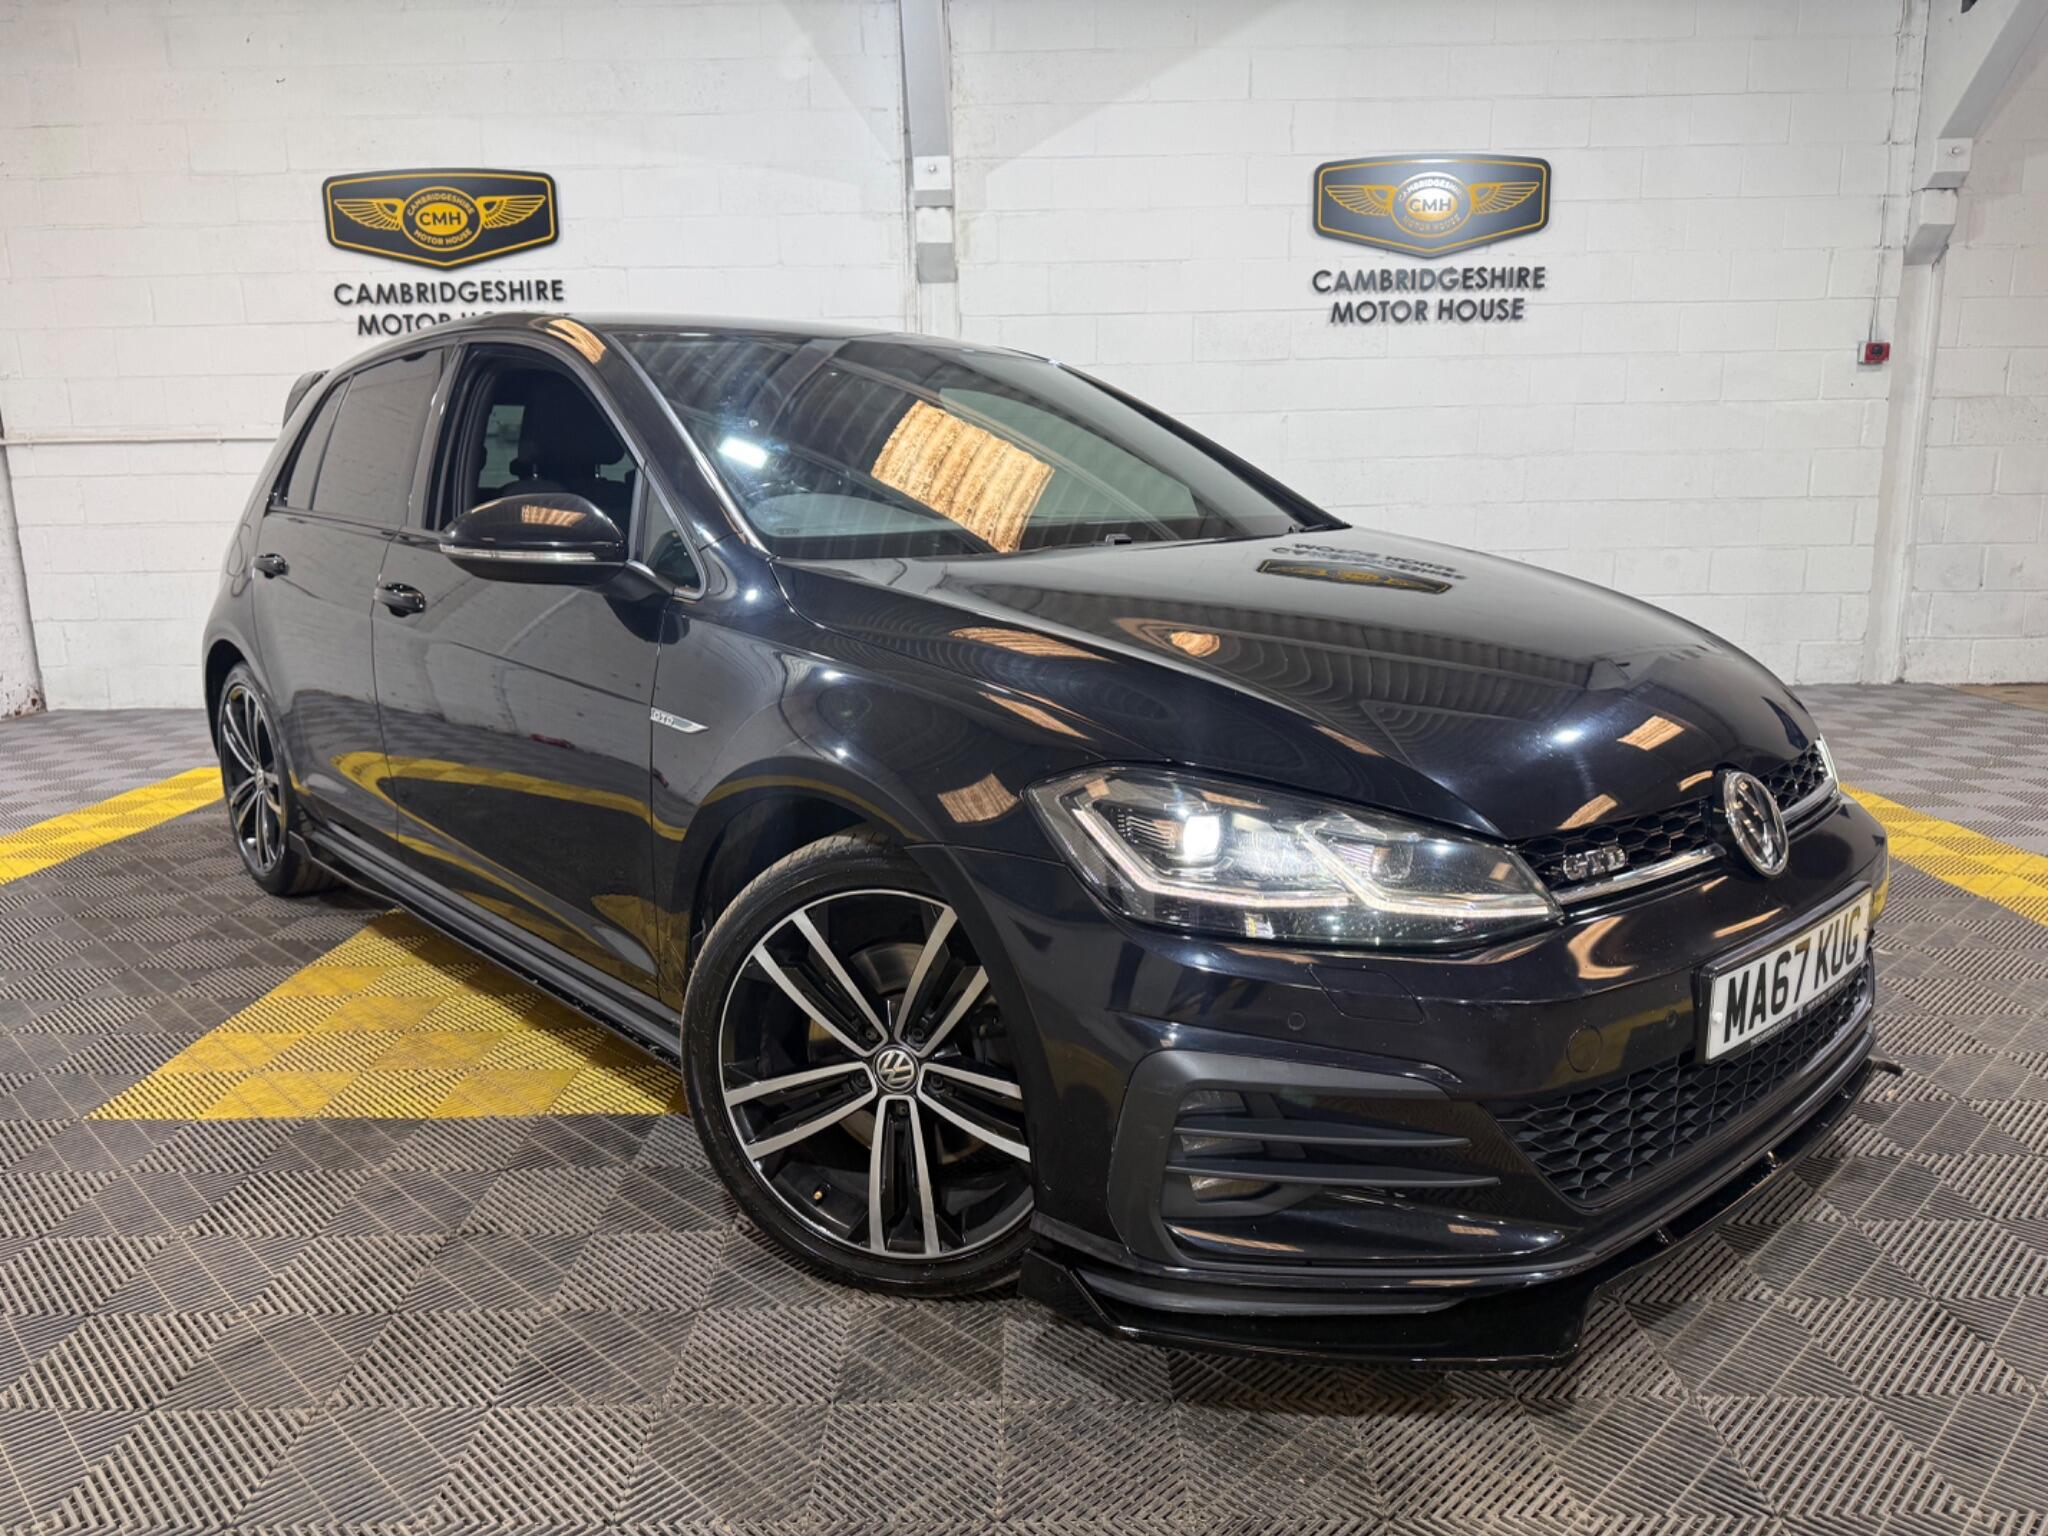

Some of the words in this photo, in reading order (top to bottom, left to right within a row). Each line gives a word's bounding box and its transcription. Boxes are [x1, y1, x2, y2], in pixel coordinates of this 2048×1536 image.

[407, 192, 475, 216] CAMBRIDGESHIRE
[1409, 198, 1452, 212] CMH
[419, 211, 461, 226] CMH
[414, 228, 444, 246] MOTOR
[445, 227, 473, 245] HOUSE
[1312, 266, 1546, 293] CAMBRIDGESHIRE
[334, 279, 564, 306] CAMBRIDGESHIRE
[1330, 299, 1428, 324] MOTOR
[1437, 297, 1525, 321] HOUSE
[1723, 936, 1811, 1044] MA67
[1813, 905, 1861, 991] KUG
